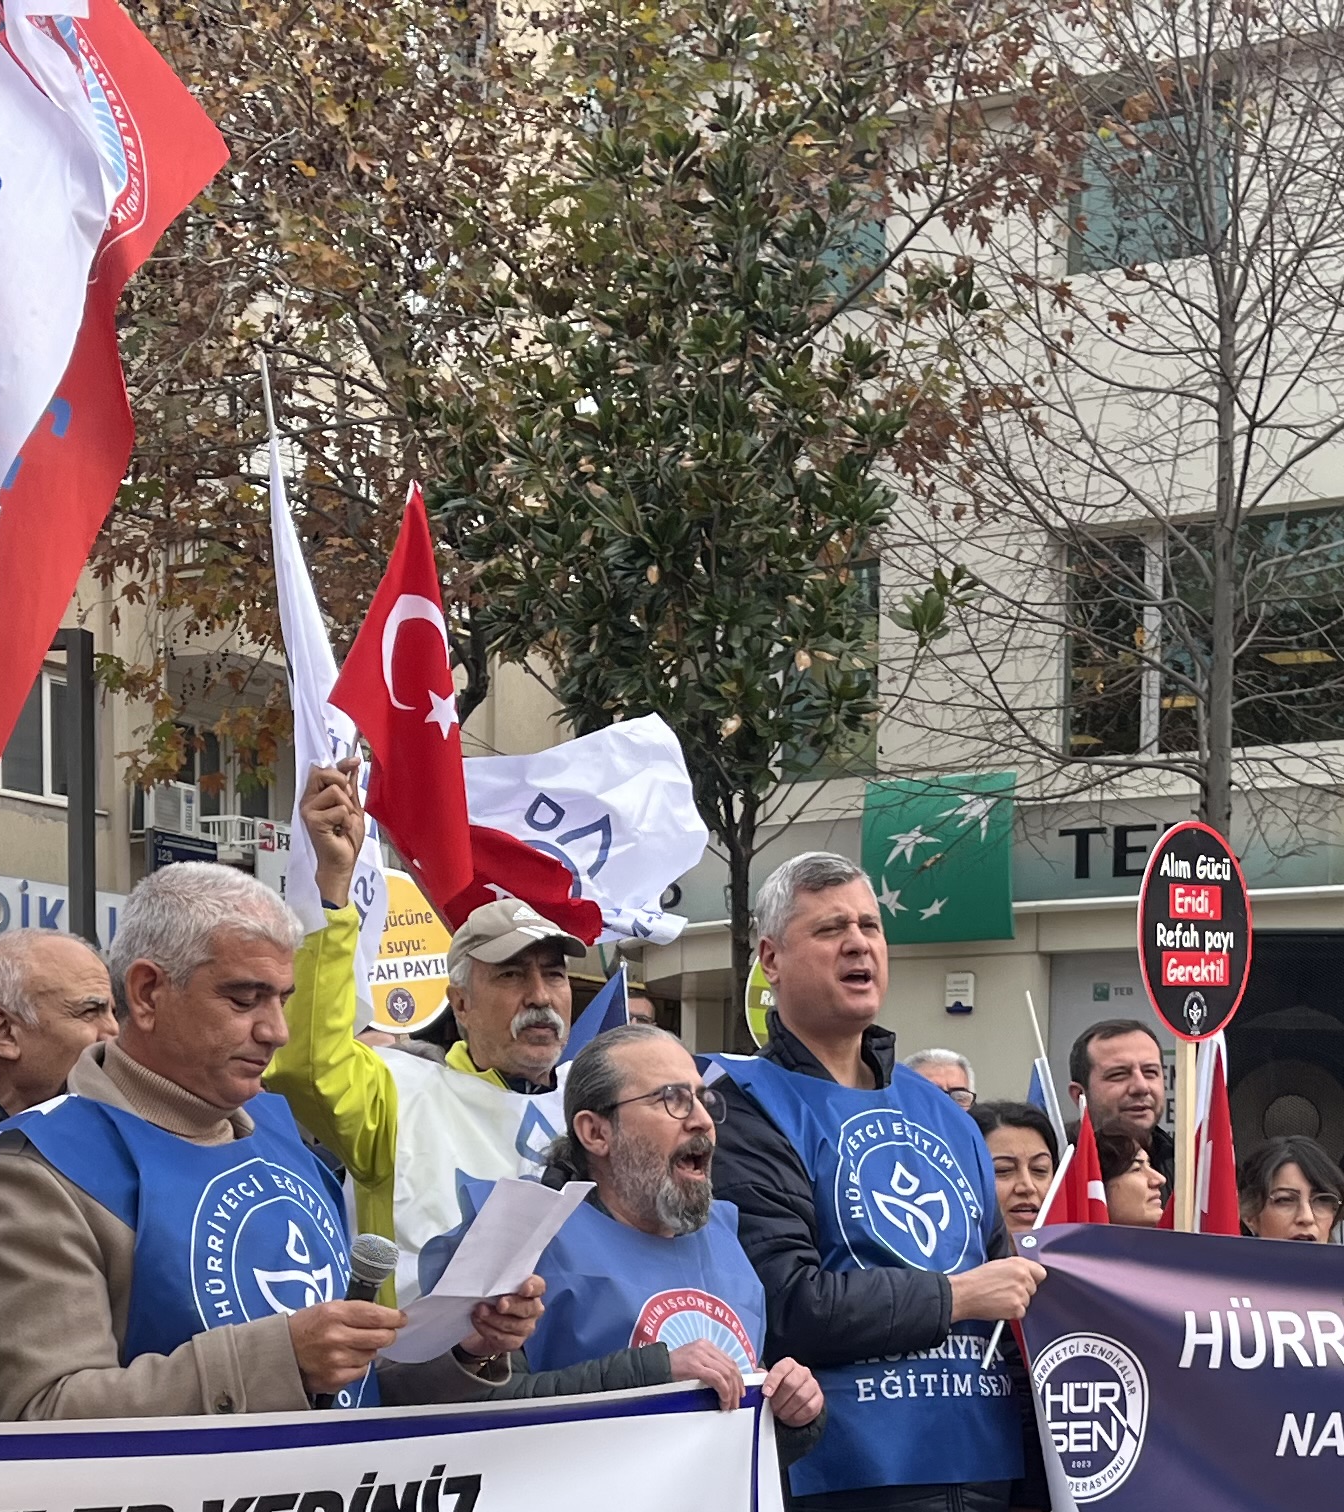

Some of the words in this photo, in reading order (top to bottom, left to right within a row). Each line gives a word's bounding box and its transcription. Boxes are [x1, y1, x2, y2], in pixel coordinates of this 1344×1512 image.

[1058, 823, 1158, 880] TE
[1159, 852, 1192, 880] Alım
[1195, 854, 1231, 882] Gücü
[1173, 888, 1216, 918] Eridi,
[1155, 922, 1200, 949] Refah
[1204, 931, 1235, 955] payı
[403, 957, 446, 980] PAYI!
[1166, 957, 1225, 983] Gerekti!
[1113, 986, 1134, 996] TEB
[205, 1173, 264, 1319] HÜRRİYETÇİ
[855, 1368, 973, 1402] EĞİTİM
[1035, 1341, 1080, 1390] ÜRRİYETÇİ
[1082, 1342, 1136, 1397] SENDİKALAR
[1047, 1419, 1119, 1453] SEN
[1068, 1455, 1126, 1493] DERASYONU
